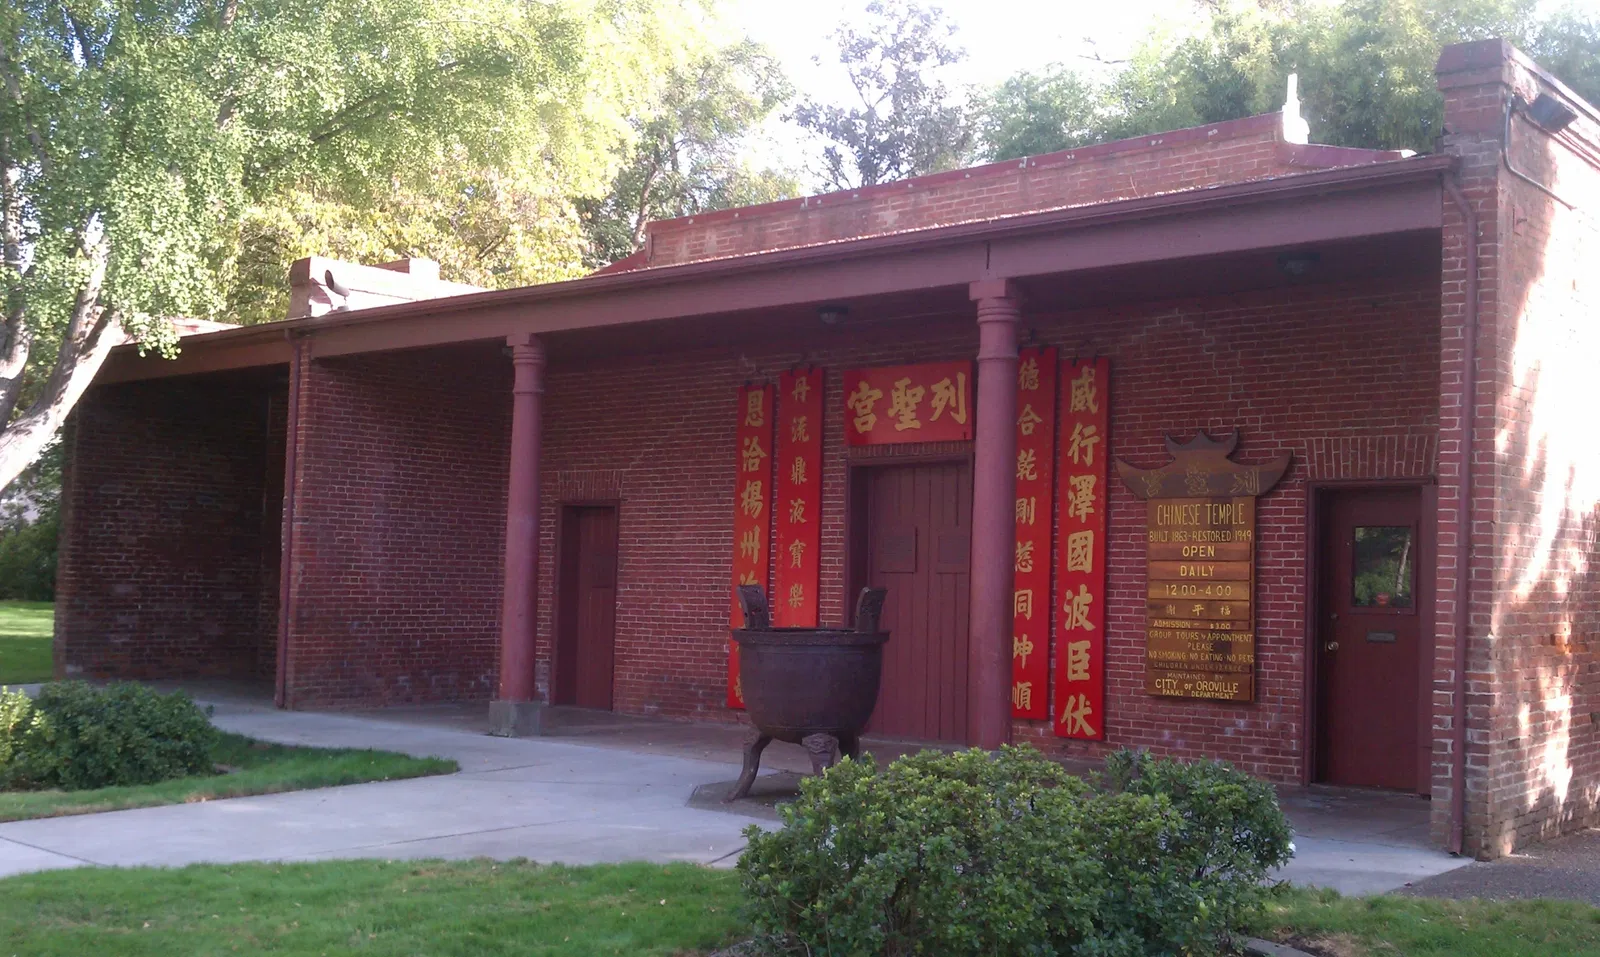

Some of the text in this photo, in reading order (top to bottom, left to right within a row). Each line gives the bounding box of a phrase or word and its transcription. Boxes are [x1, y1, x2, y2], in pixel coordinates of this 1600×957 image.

[1157, 503, 1245, 526] CHINESE TEMPLE
[1149, 530, 1169, 542] BUILT
[1235, 529, 1252, 541] 1949
[1061, 365, 1099, 737] 威行澤國波臣伏
[1182, 545, 1215, 557] OPEN
[1180, 565, 1215, 577] DAILY
[1153, 620, 1191, 629] ADMISSION
[1149, 630, 1172, 639] GROUP
[1176, 631, 1199, 640] TOURS
[1207, 633, 1253, 642] APPOINTMENT
[1187, 642, 1214, 651] PLEASE
[1148, 651, 1157, 659] NO
[1190, 652, 1199, 660] NO
[1201, 653, 1223, 662] EATING
[1227, 654, 1236, 662] NO
[1167, 672, 1206, 680] MAINTAINED
[1155, 679, 1178, 689] CITY
[1196, 681, 1239, 693] OROVILLE
[1191, 690, 1234, 699] DEPARTMENT
